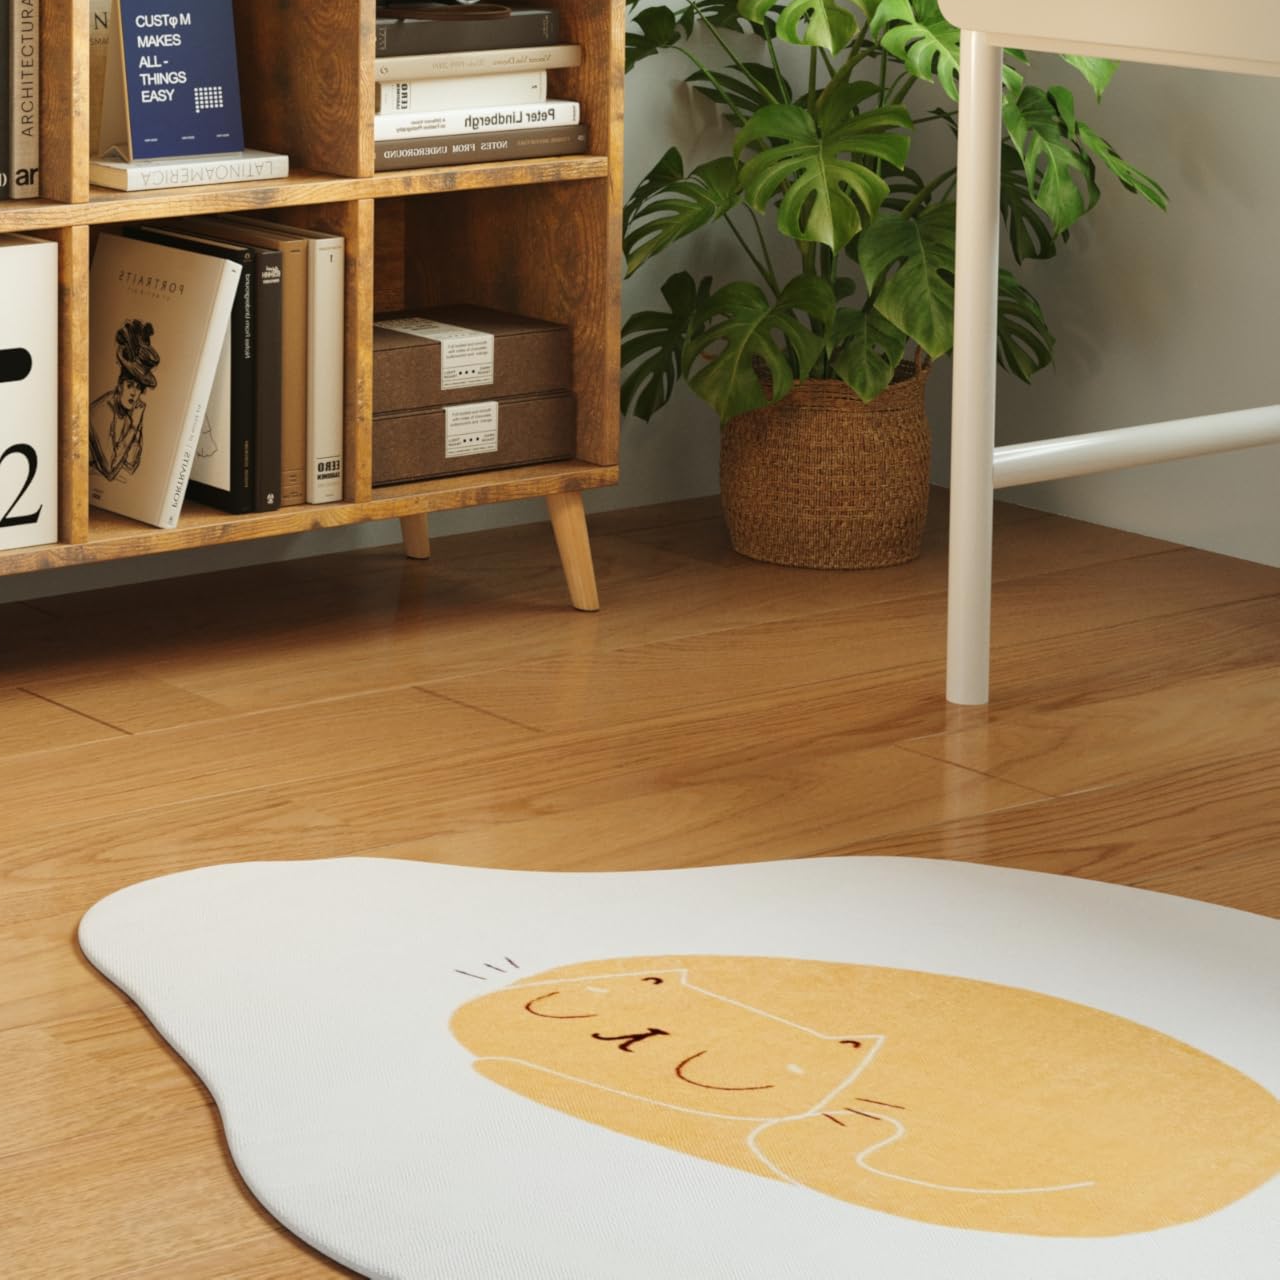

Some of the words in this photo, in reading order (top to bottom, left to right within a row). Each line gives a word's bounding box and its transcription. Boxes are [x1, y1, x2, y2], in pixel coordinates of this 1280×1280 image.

[137, 34, 182, 49] MAKES
[140, 71, 187, 86] THINGS
[142, 89, 175, 104] EASY
[15, 166, 38, 186] ar
[141, 161, 273, 186] LATINOAMERICA
